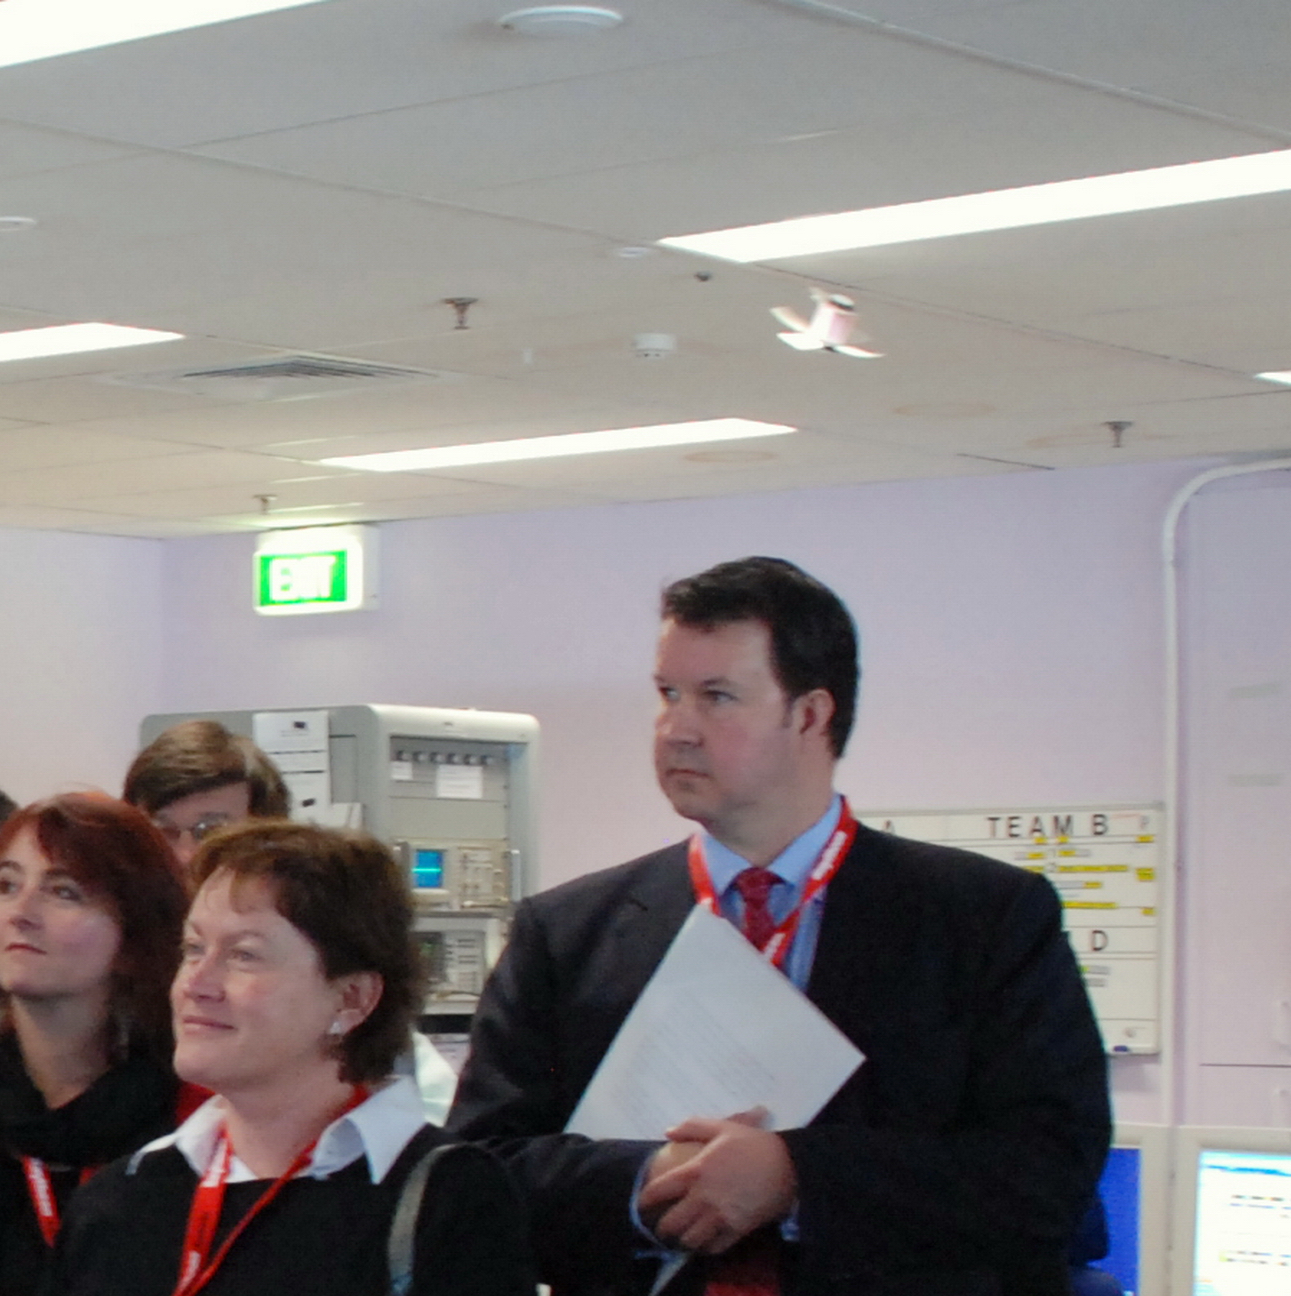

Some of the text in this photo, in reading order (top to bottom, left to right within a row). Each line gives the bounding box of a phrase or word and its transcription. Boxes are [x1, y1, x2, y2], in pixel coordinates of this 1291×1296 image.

[270, 555, 336, 600] EXIT
[986, 813, 1109, 837] TEAM B
[1090, 930, 1109, 952] D
